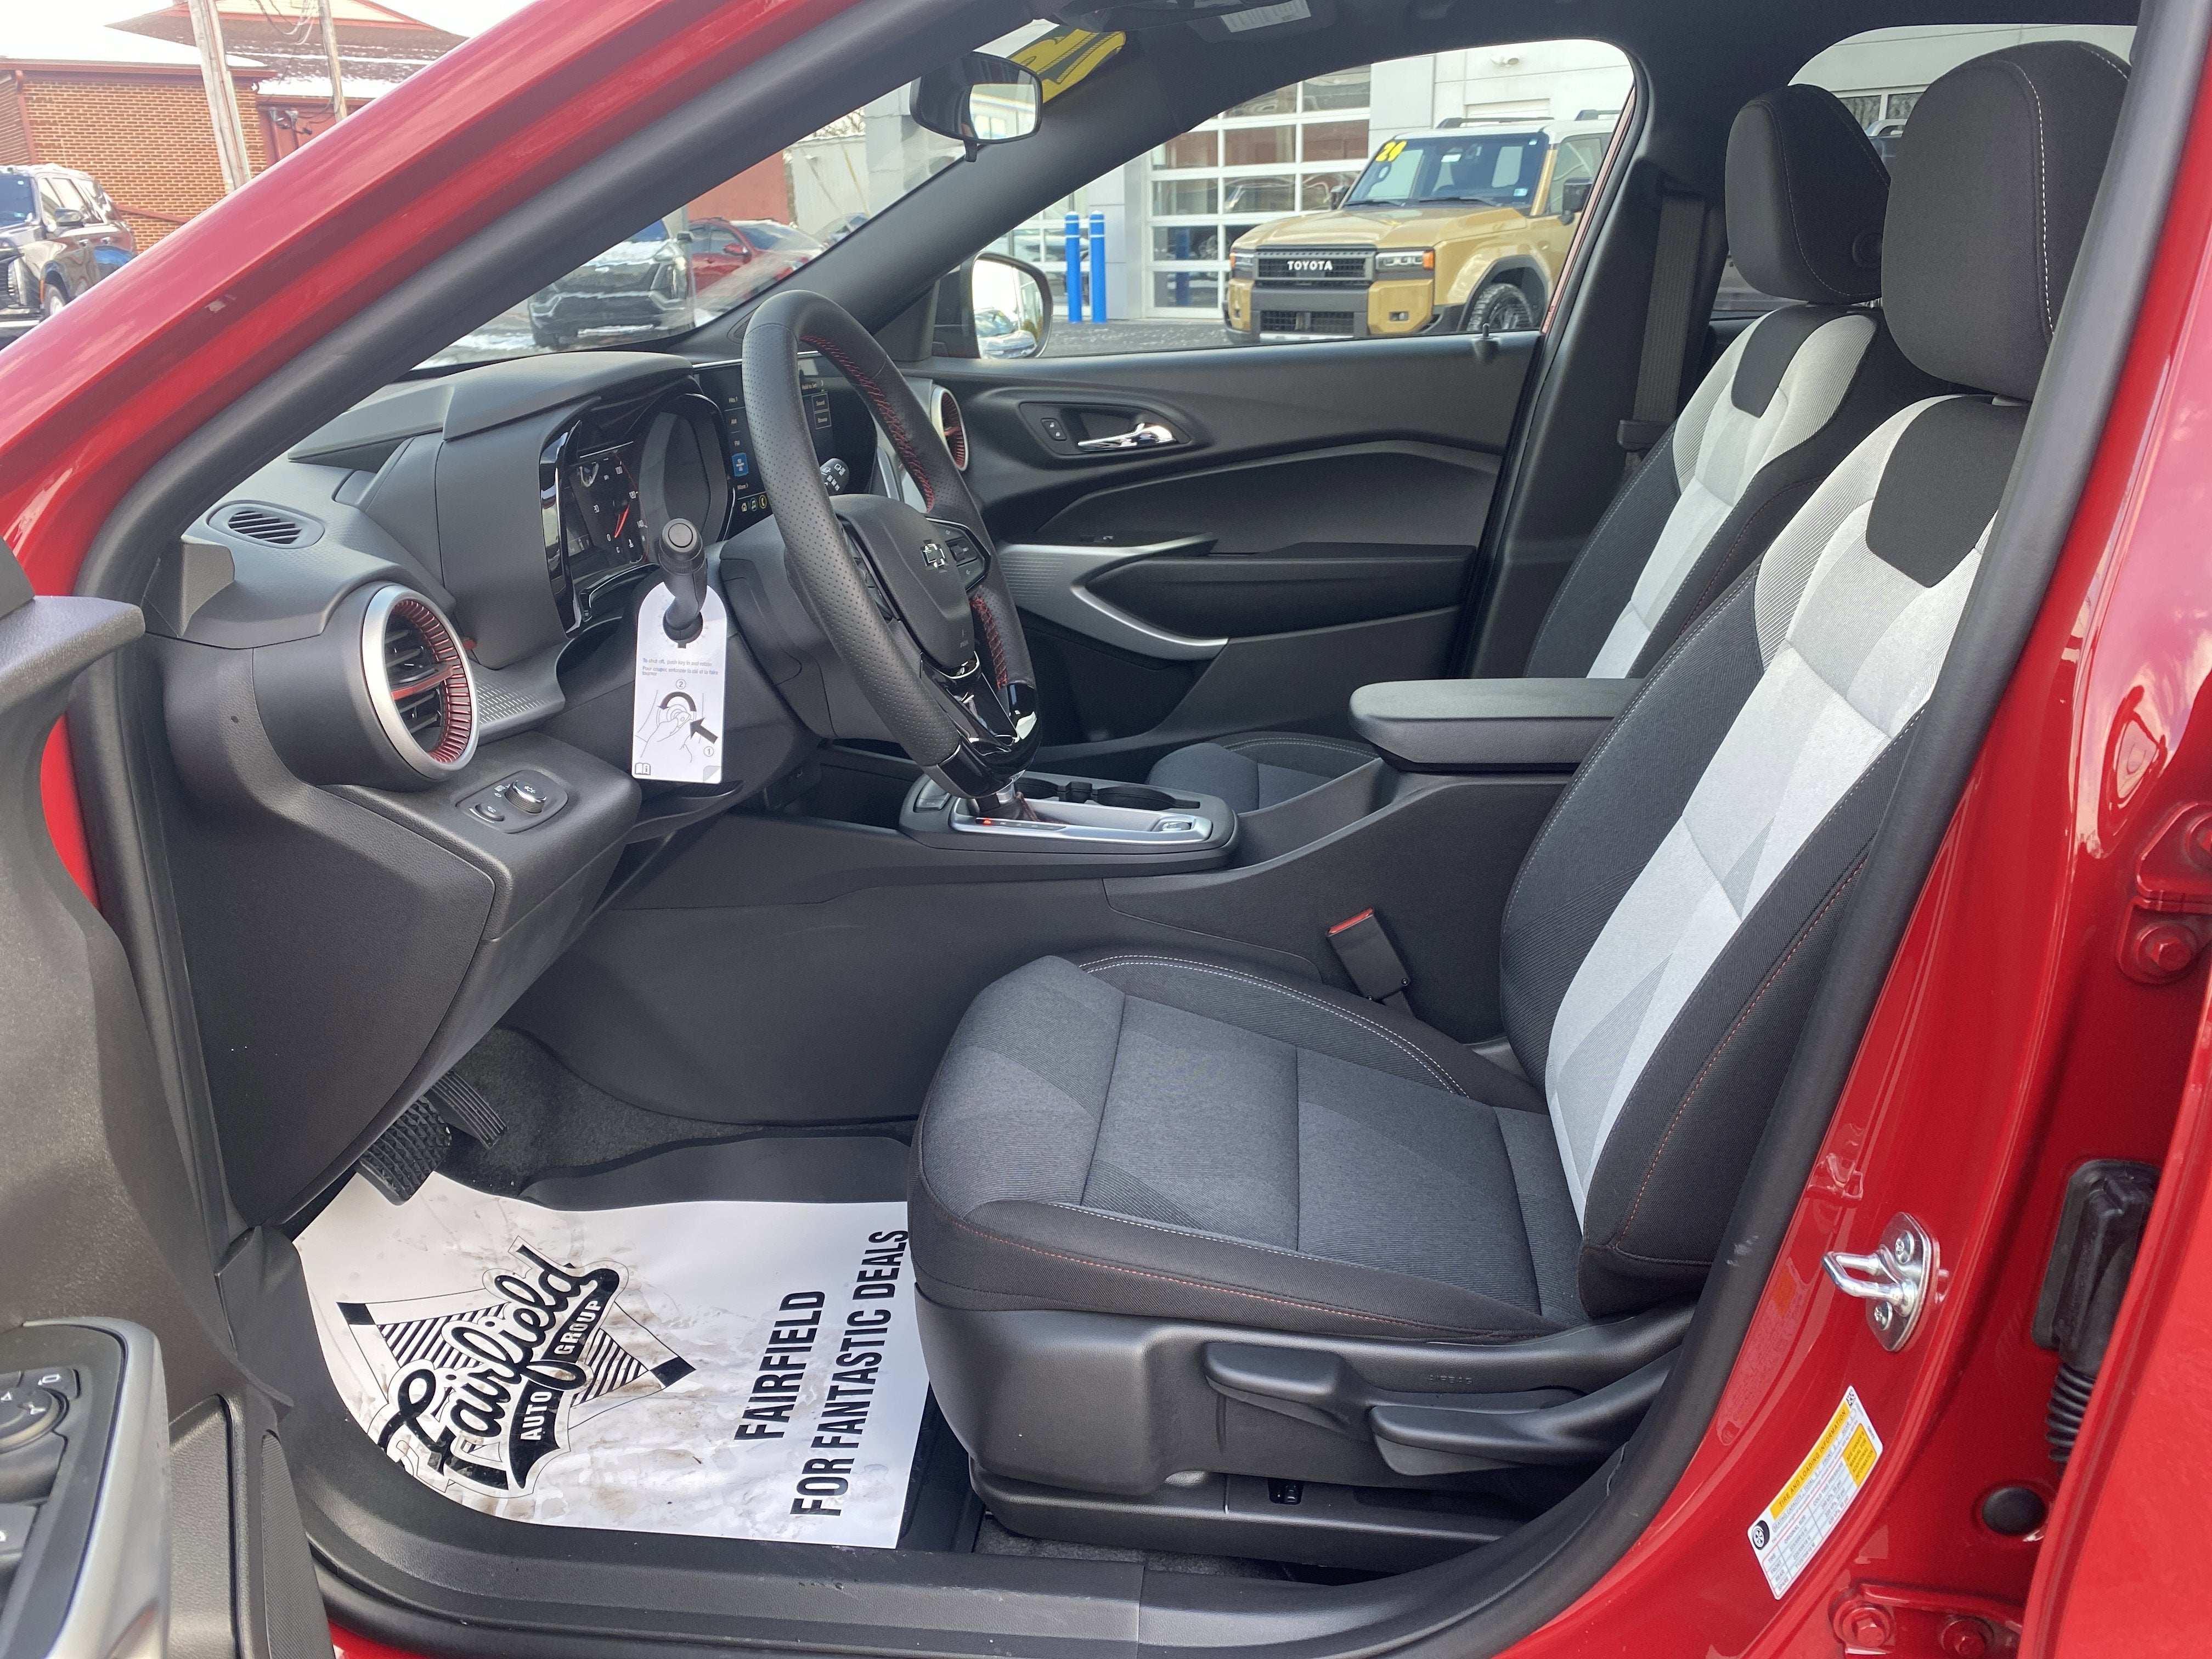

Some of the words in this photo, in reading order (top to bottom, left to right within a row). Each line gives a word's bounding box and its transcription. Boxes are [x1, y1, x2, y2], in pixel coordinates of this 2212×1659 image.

[1287, 261, 1333, 270] TOYOTA
[853, 1230, 909, 1300] DEALS
[377, 1242, 619, 1490] Fairfield
[521, 1391, 552, 1441] AUTO
[554, 1300, 601, 1355] GROUP
[733, 1291, 825, 1440] FAIRFIELD
[810, 1309, 891, 1448] FANTASTIC
[790, 1458, 855, 1516] FOR
[1779, 1492, 1790, 1506] TIRE
[1790, 1479, 1799, 1493] AND
[1799, 1452, 1819, 1480] LOADING
[1819, 1409, 1846, 1452] INFORMATION
